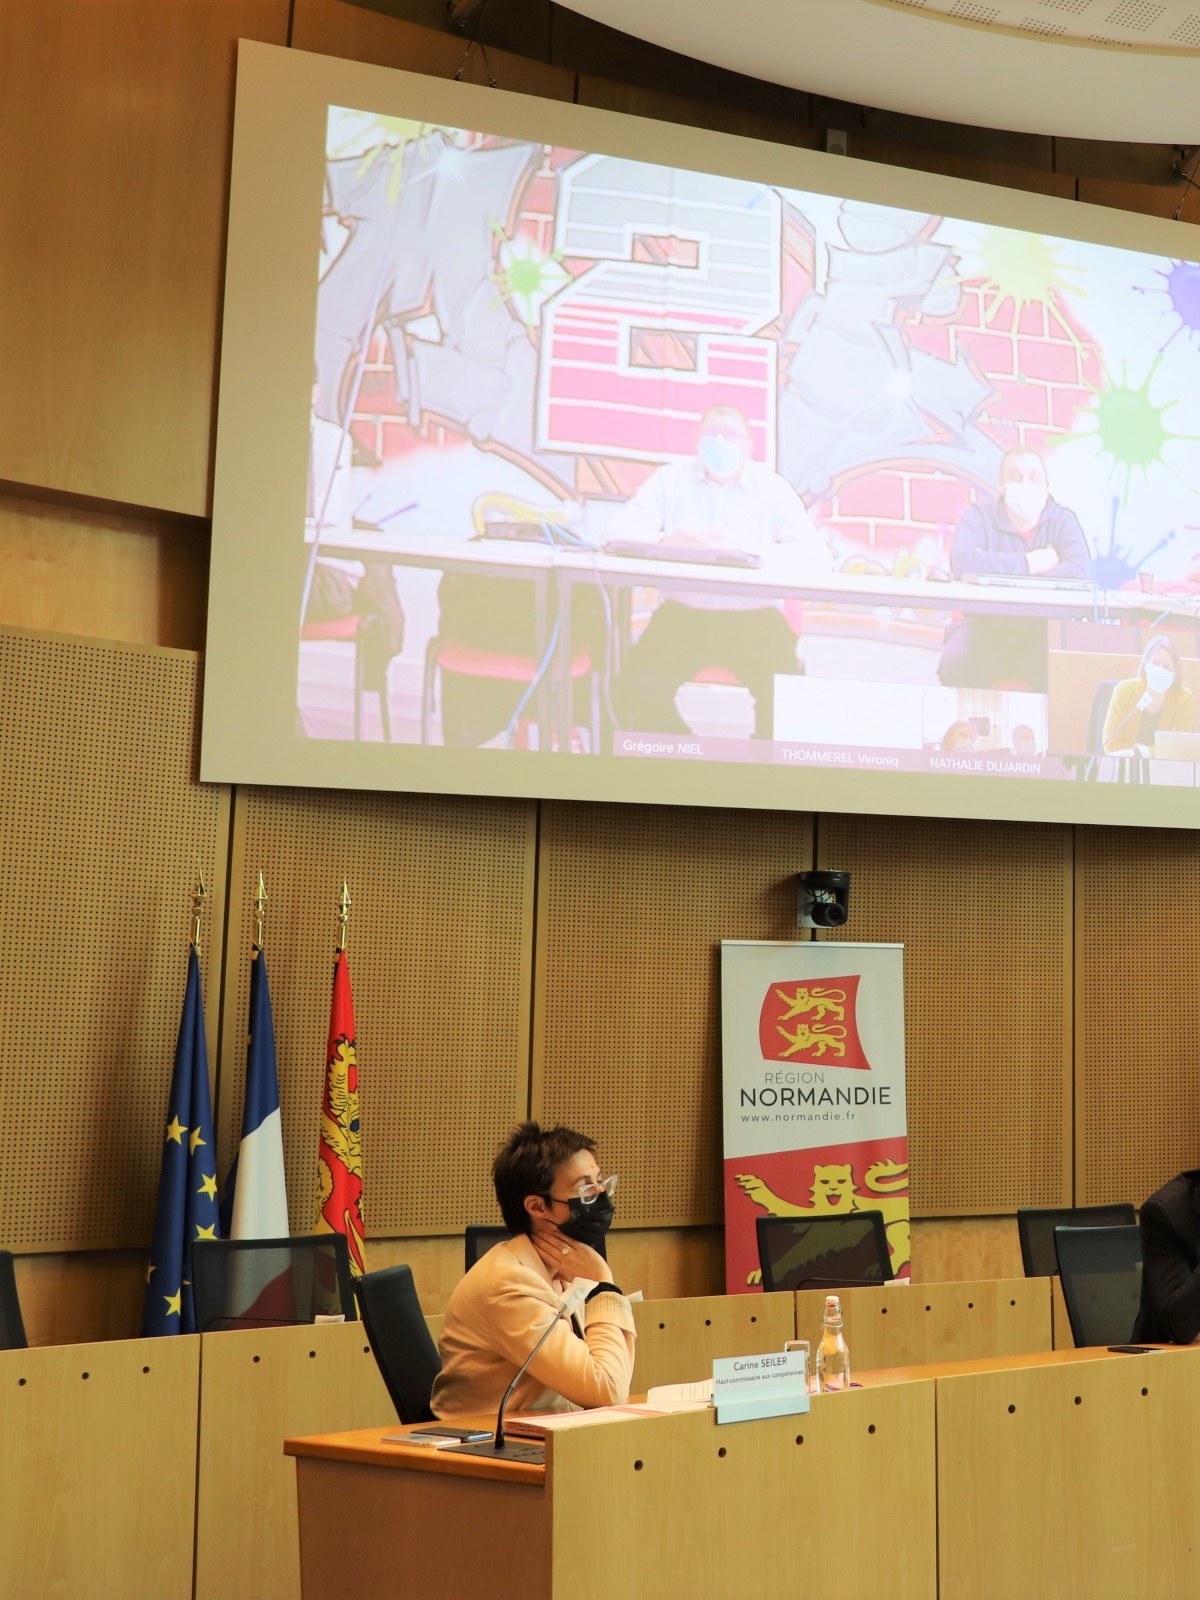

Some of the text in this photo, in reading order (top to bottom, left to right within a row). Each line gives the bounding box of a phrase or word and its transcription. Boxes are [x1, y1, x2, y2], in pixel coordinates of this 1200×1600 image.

[623, 739, 705, 755] Grégoire NIEL
[781, 748, 900, 768] THOMMEREL Veroniq
[930, 757, 1041, 774] NATHALIE DUJARDIN
[764, 1070, 825, 1084] RÉGION
[740, 1086, 892, 1107] NORMANDIE
[741, 1111, 856, 1122] www.normandie.fr
[734, 1356, 787, 1370] Carine SEILER
[716, 1375, 760, 1384] Haut-commissaire
[772, 1370, 804, 1378] compétences
